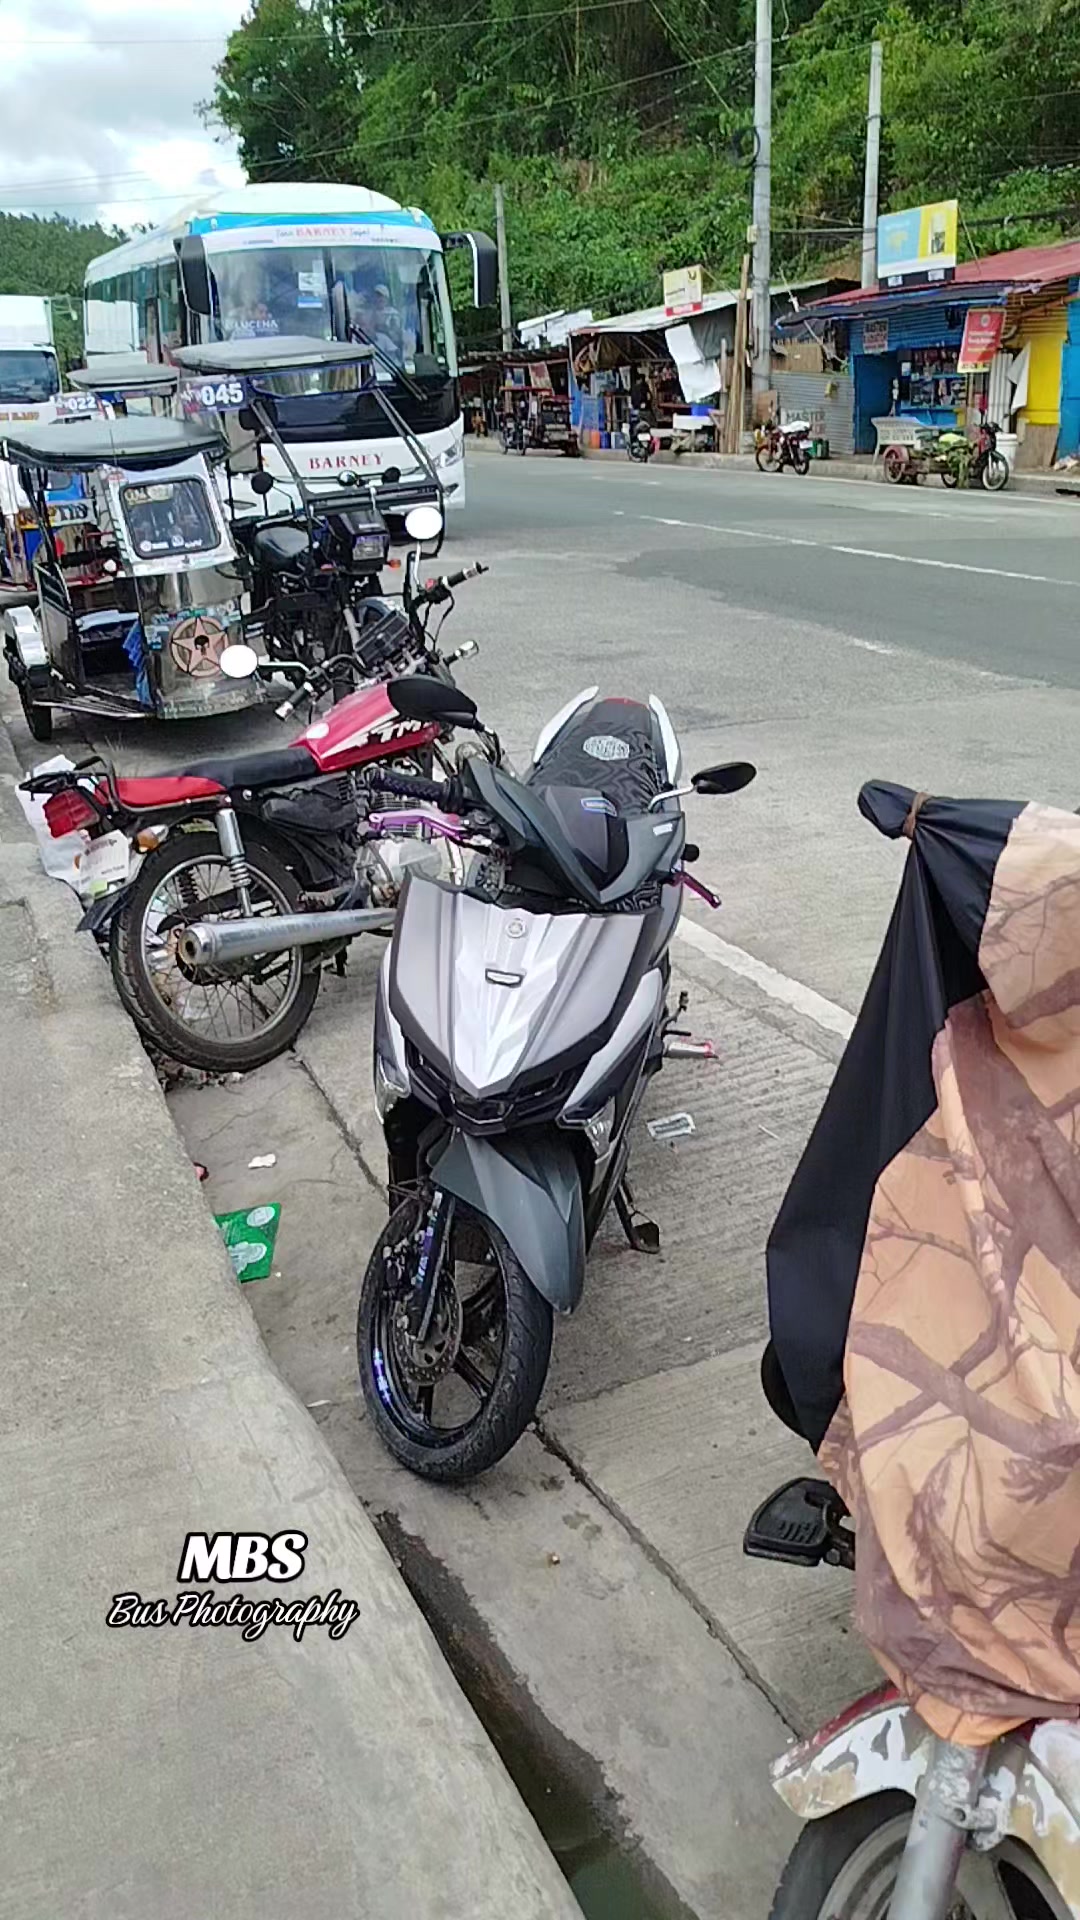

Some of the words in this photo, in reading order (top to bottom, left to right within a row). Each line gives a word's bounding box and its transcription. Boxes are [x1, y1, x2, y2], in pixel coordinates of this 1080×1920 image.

[68, 396, 98, 410] 022
[201, 383, 244, 406] 045
[309, 452, 384, 470] BARNEY
